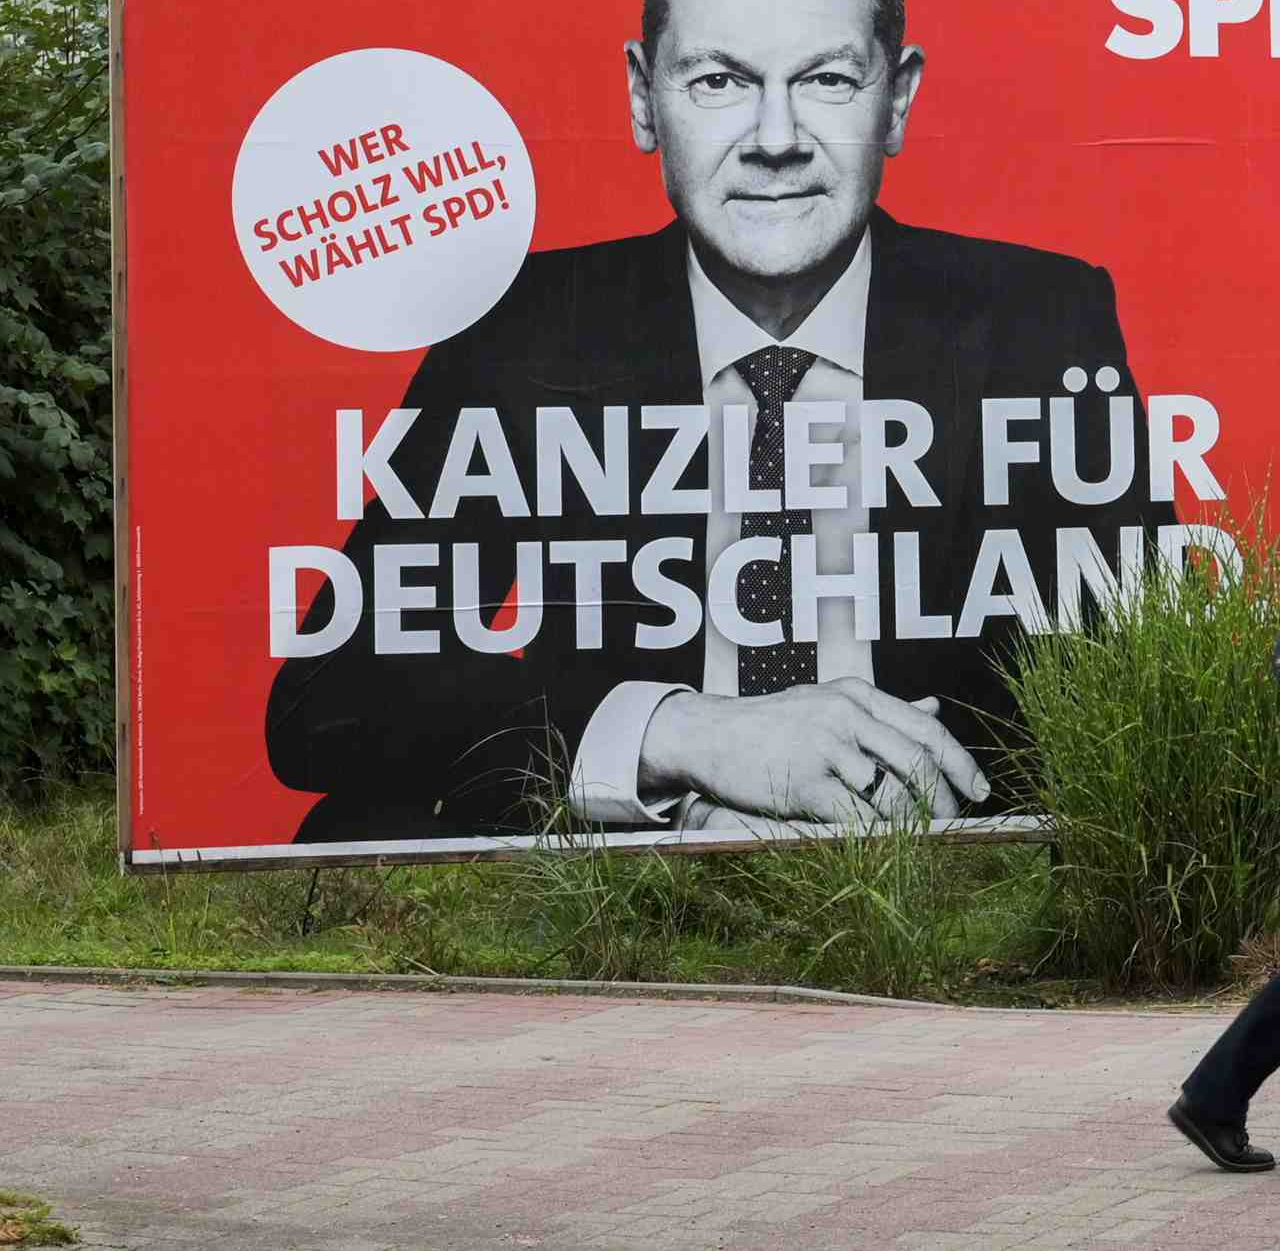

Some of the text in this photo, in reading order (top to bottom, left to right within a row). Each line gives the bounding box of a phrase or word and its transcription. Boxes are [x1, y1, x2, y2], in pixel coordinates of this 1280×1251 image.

[254, 141, 509, 252] SCHOLZ WILL,
[319, 124, 411, 178] WER
[280, 178, 510, 288] WÄHLT SPD!
[336, 366, 1227, 520] KANZLER FÜR
